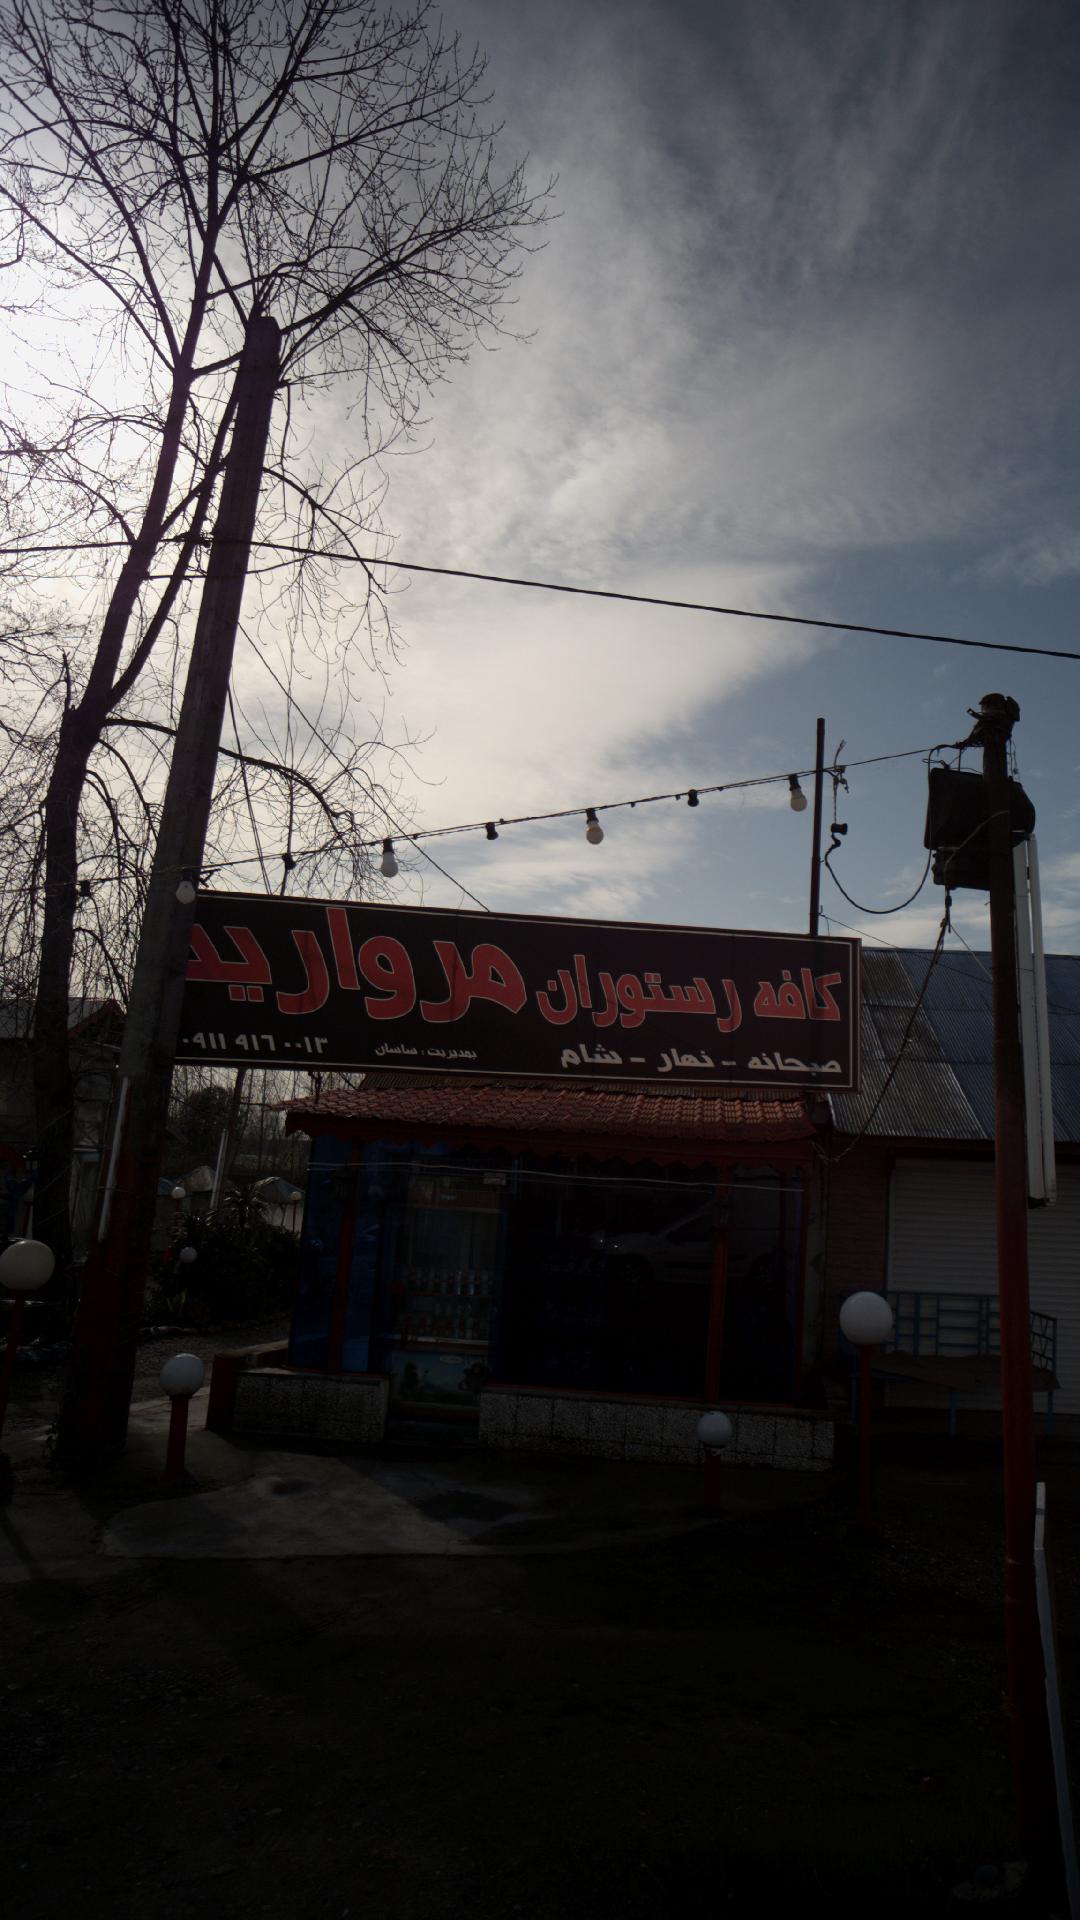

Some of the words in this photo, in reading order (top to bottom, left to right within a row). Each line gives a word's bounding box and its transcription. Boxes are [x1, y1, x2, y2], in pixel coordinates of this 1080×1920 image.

[535, 954, 743, 1034] رستوران
[753, 967, 842, 1022] کافه
[560, 1043, 624, 1069] شام
[656, 1047, 716, 1073] نهار
[747, 1051, 842, 1077] صبحانه
